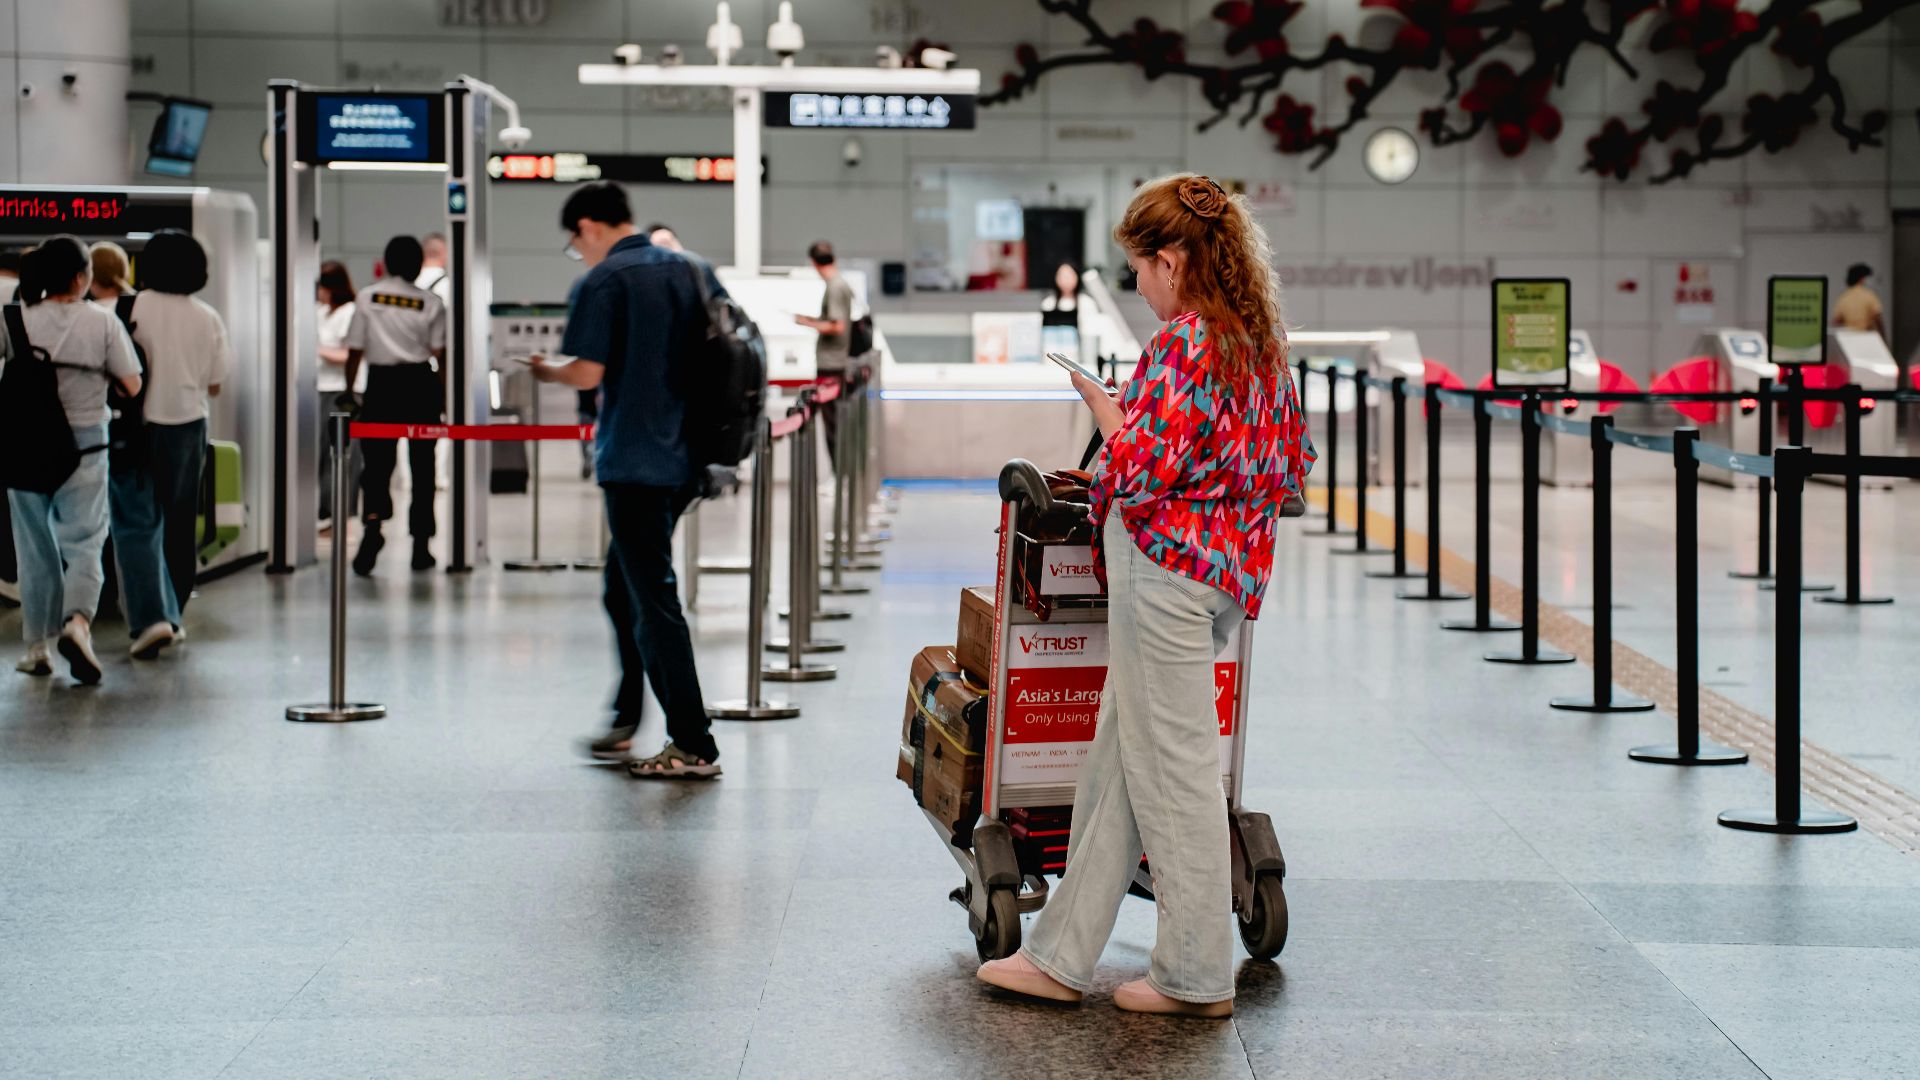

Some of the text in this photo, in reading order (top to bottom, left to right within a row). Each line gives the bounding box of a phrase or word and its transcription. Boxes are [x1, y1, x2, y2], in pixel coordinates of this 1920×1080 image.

[1016, 688, 1060, 703] Asia's
[1025, 713, 1054, 726] Only
[1057, 712, 1090, 725] Using
[1049, 749, 1068, 757] INDIA
